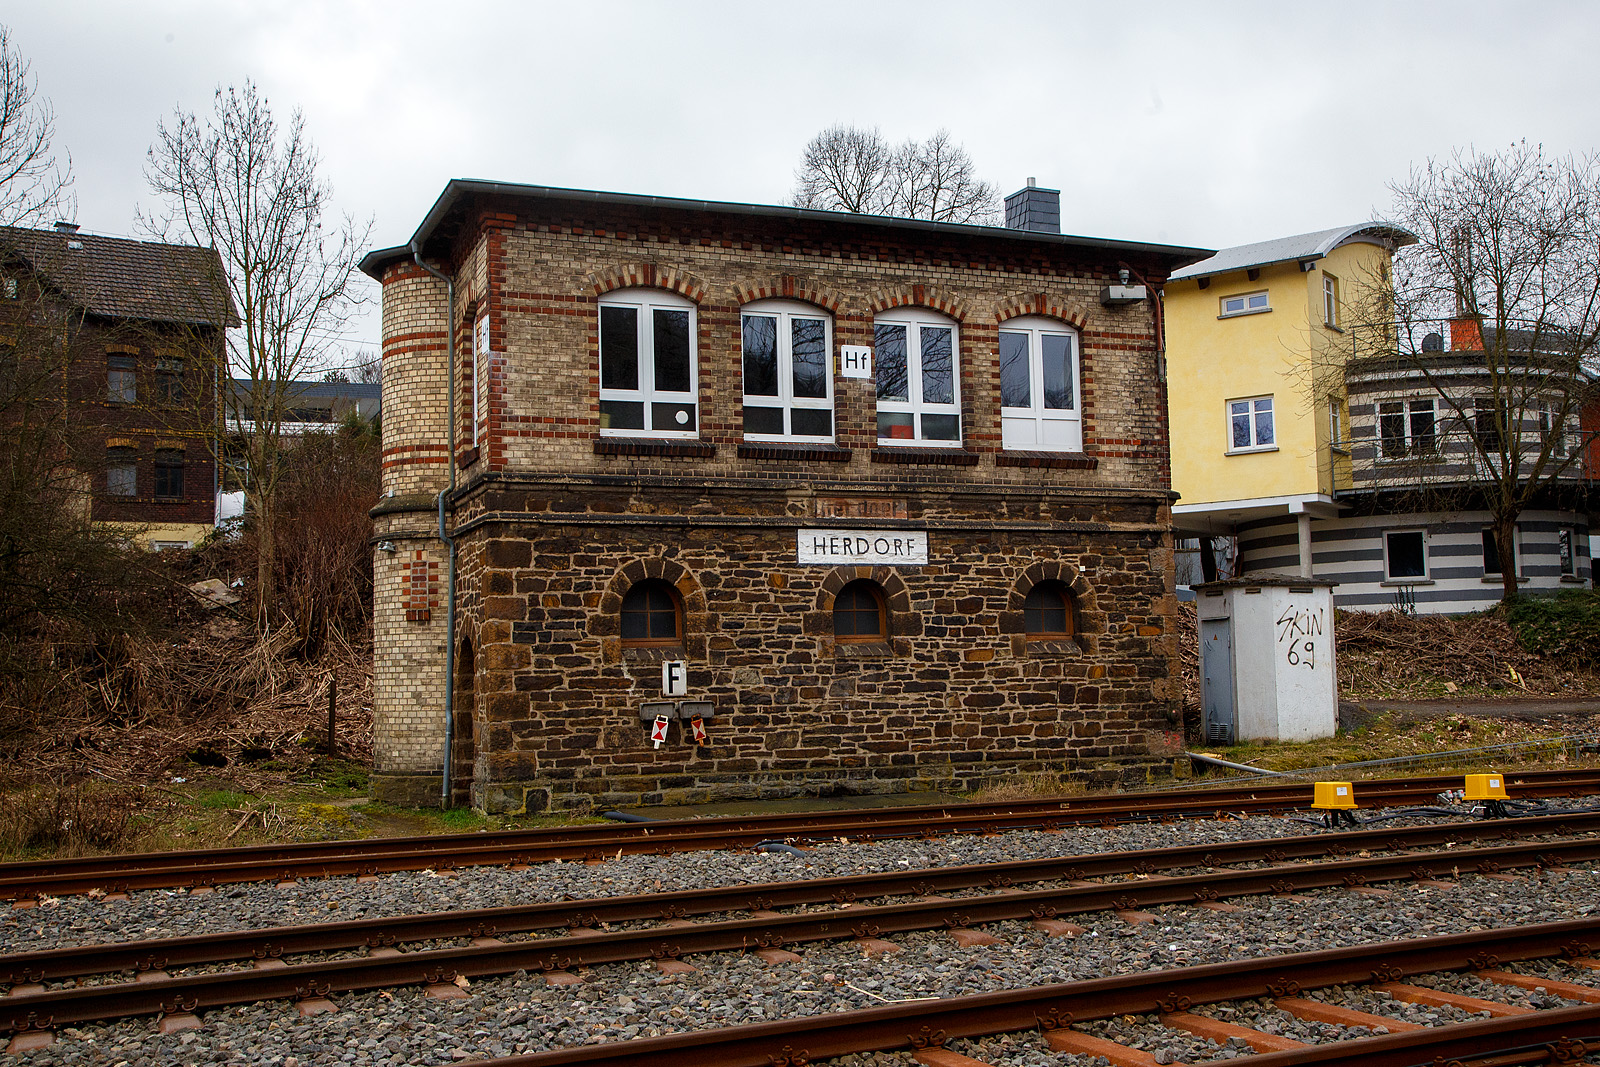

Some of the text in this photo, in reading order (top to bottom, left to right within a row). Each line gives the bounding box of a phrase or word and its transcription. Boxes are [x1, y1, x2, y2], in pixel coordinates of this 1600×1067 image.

[846, 351, 867, 370] Hf
[813, 536, 915, 556] HERDORF
[1287, 638, 1315, 670] 69
[668, 663, 681, 694] F
